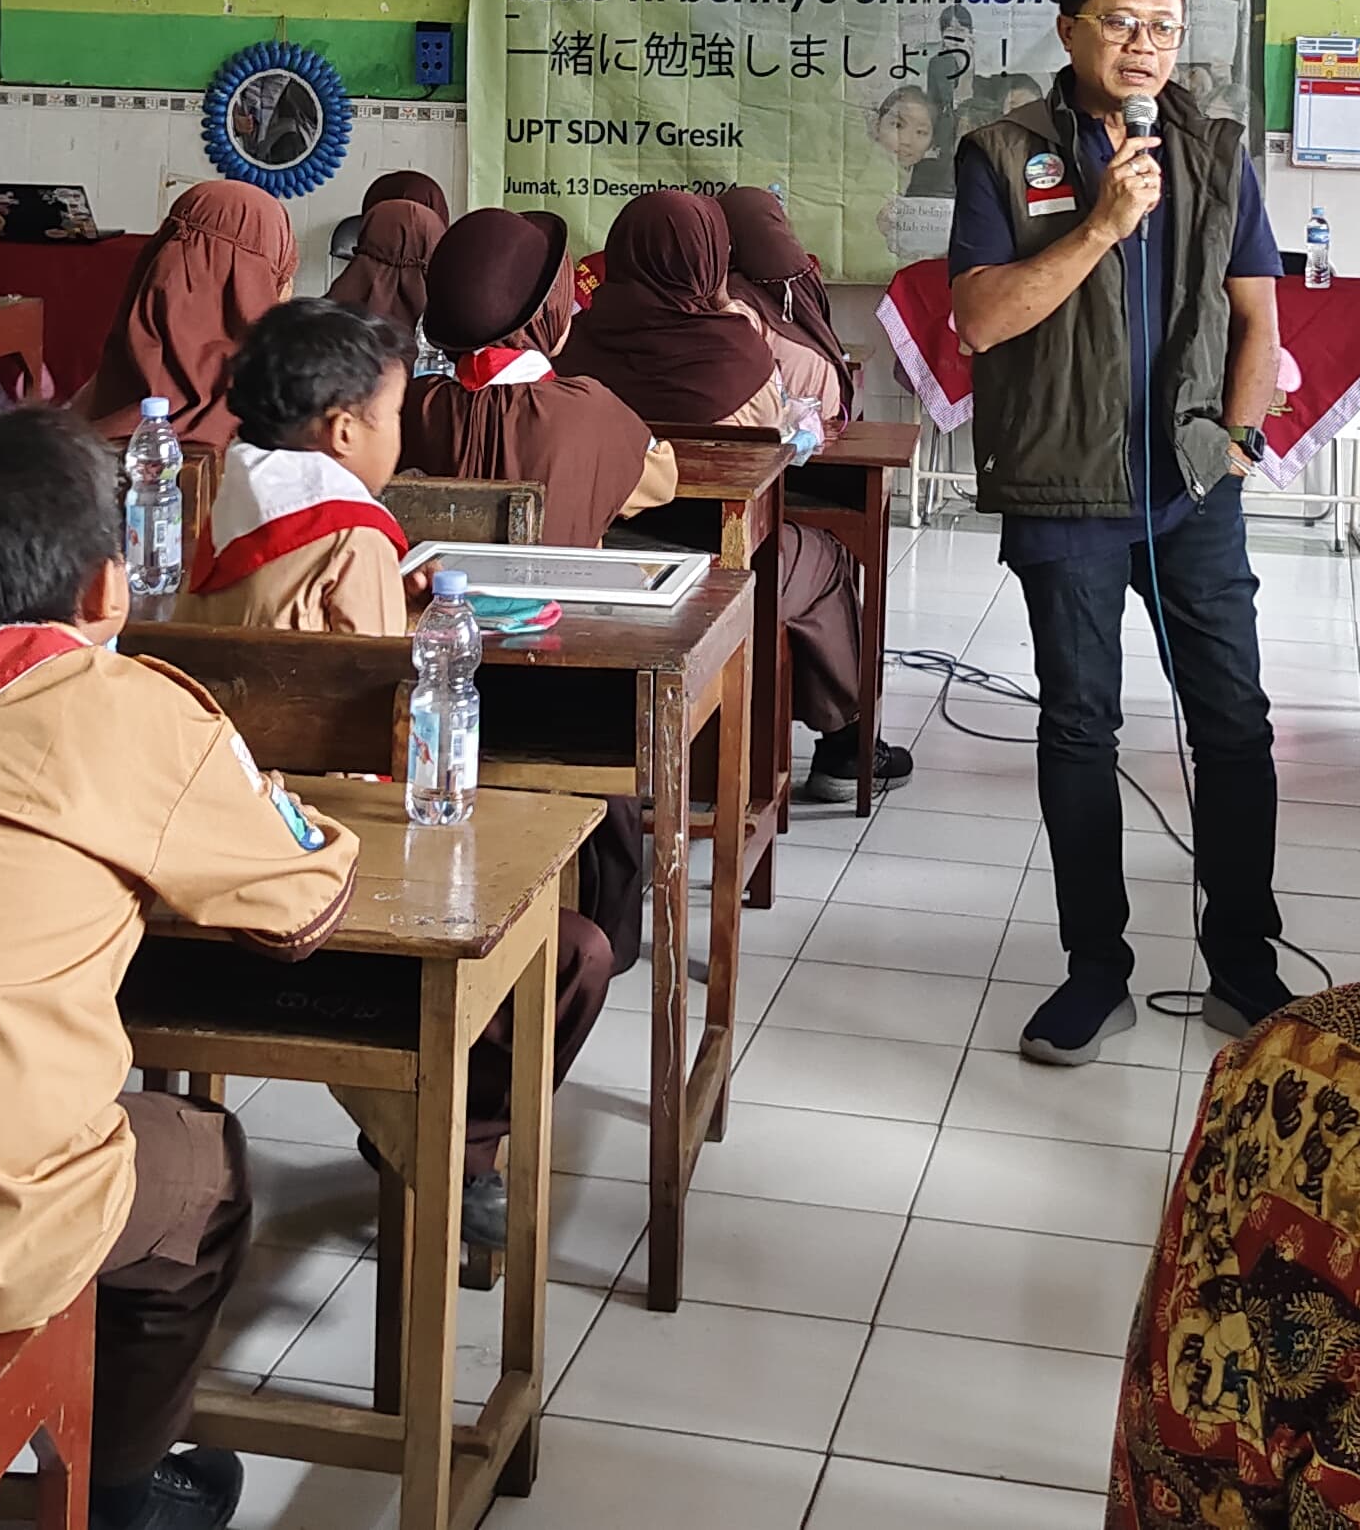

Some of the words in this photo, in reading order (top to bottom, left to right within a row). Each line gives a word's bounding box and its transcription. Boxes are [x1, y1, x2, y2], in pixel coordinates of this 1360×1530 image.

[507, 30, 1008, 79] 一緒に勉強しましょう！
[507, 118, 562, 144] UPT
[567, 120, 628, 145] SDN
[634, 121, 651, 145] 7
[656, 122, 744, 148] Gresik
[504, 177, 561, 197] Jumat,
[567, 178, 589, 195] 13
